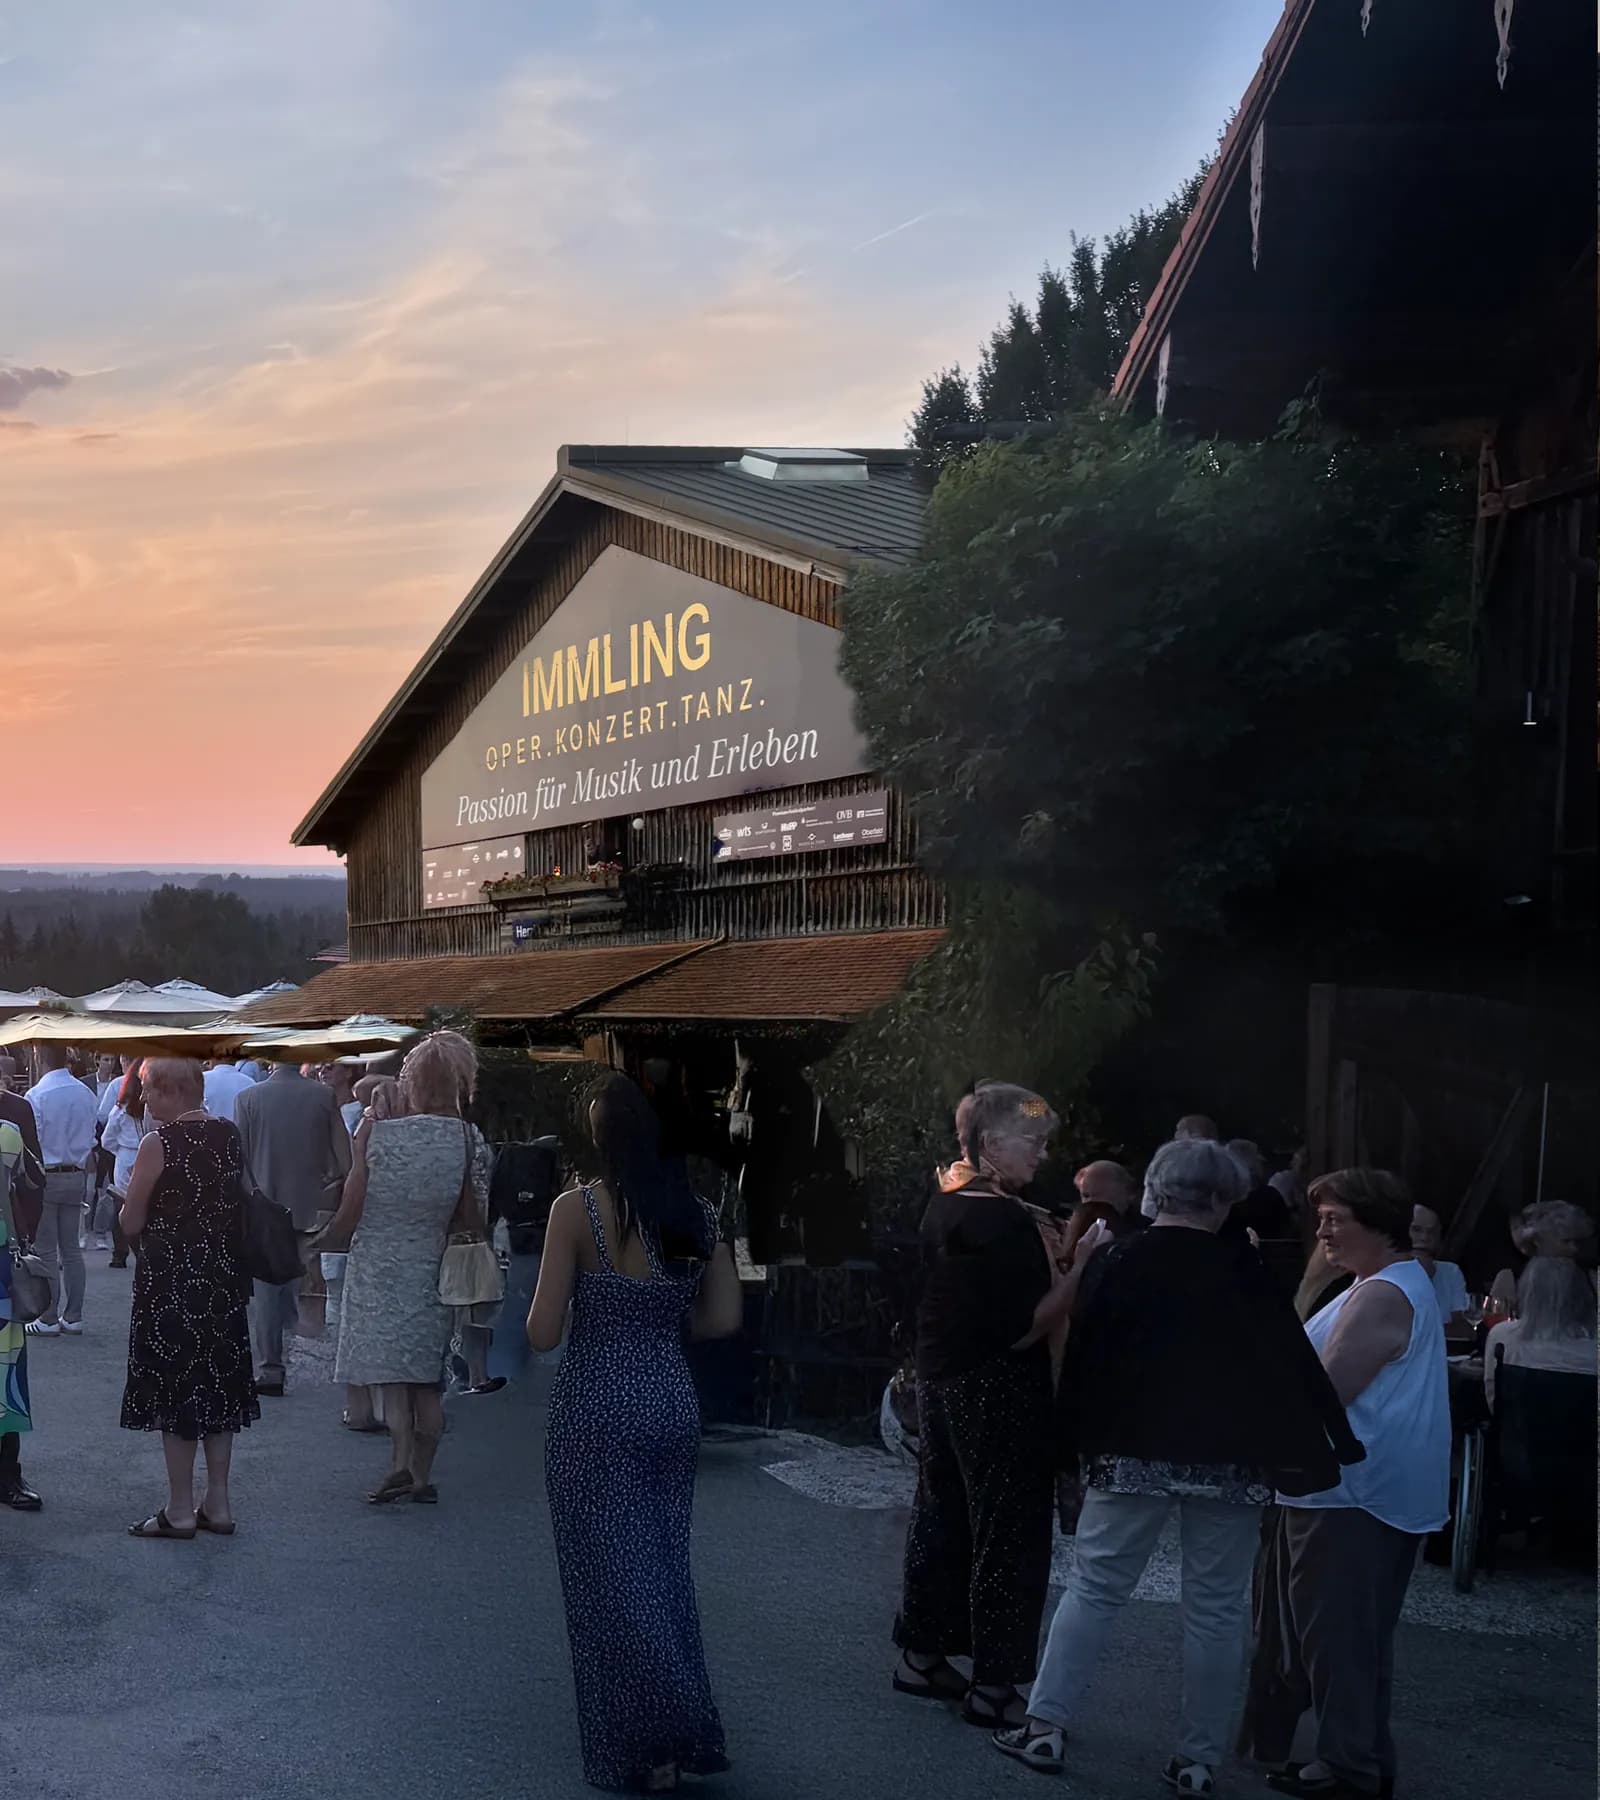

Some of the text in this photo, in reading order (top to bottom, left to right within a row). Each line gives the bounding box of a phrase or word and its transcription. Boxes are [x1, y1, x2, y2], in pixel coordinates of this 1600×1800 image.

[522, 602, 711, 717] IMMLING
[456, 727, 819, 826] Passion für Musik und Erleben
